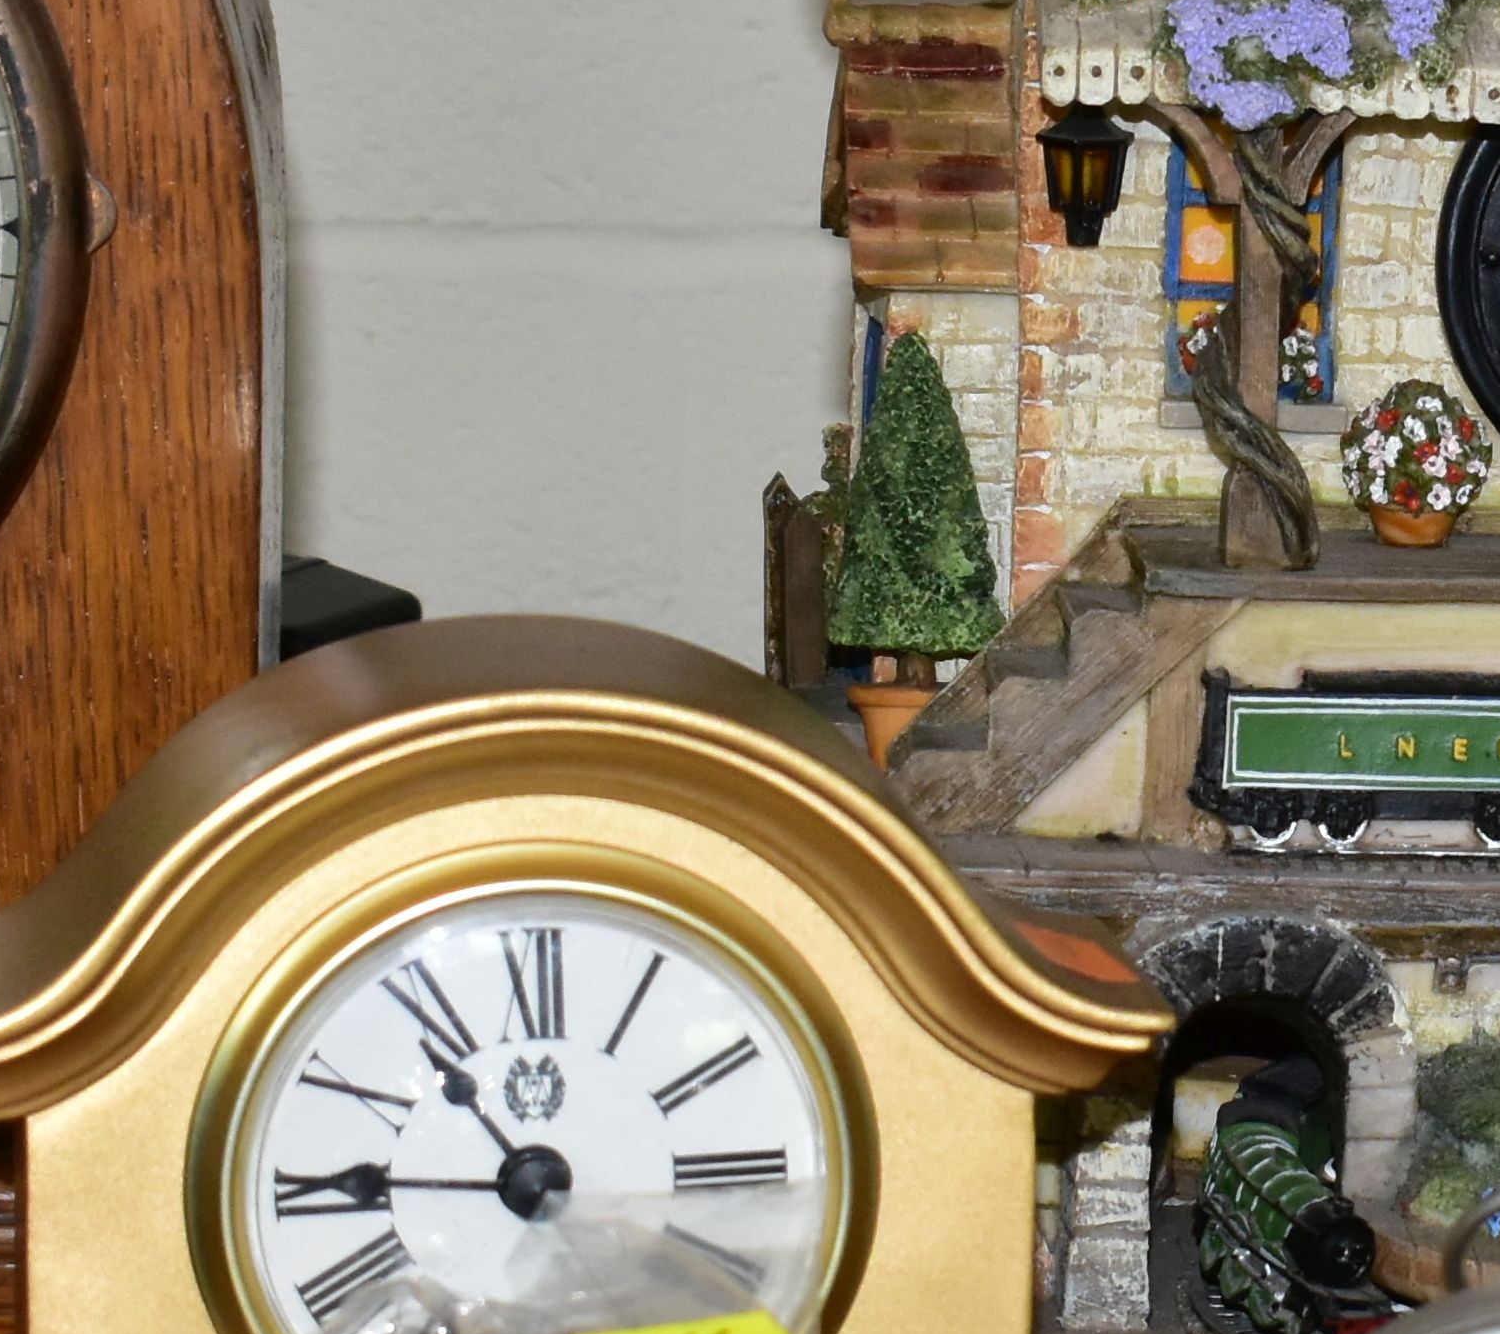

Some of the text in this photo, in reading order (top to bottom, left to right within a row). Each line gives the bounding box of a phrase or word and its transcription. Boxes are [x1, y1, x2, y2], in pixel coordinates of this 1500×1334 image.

[381, 958, 479, 1061] XI
[499, 927, 566, 1042] XII
[601, 952, 668, 1057] I
[298, 1050, 417, 1137] X
[649, 1033, 763, 1118] II
[672, 1144, 789, 1190] III
